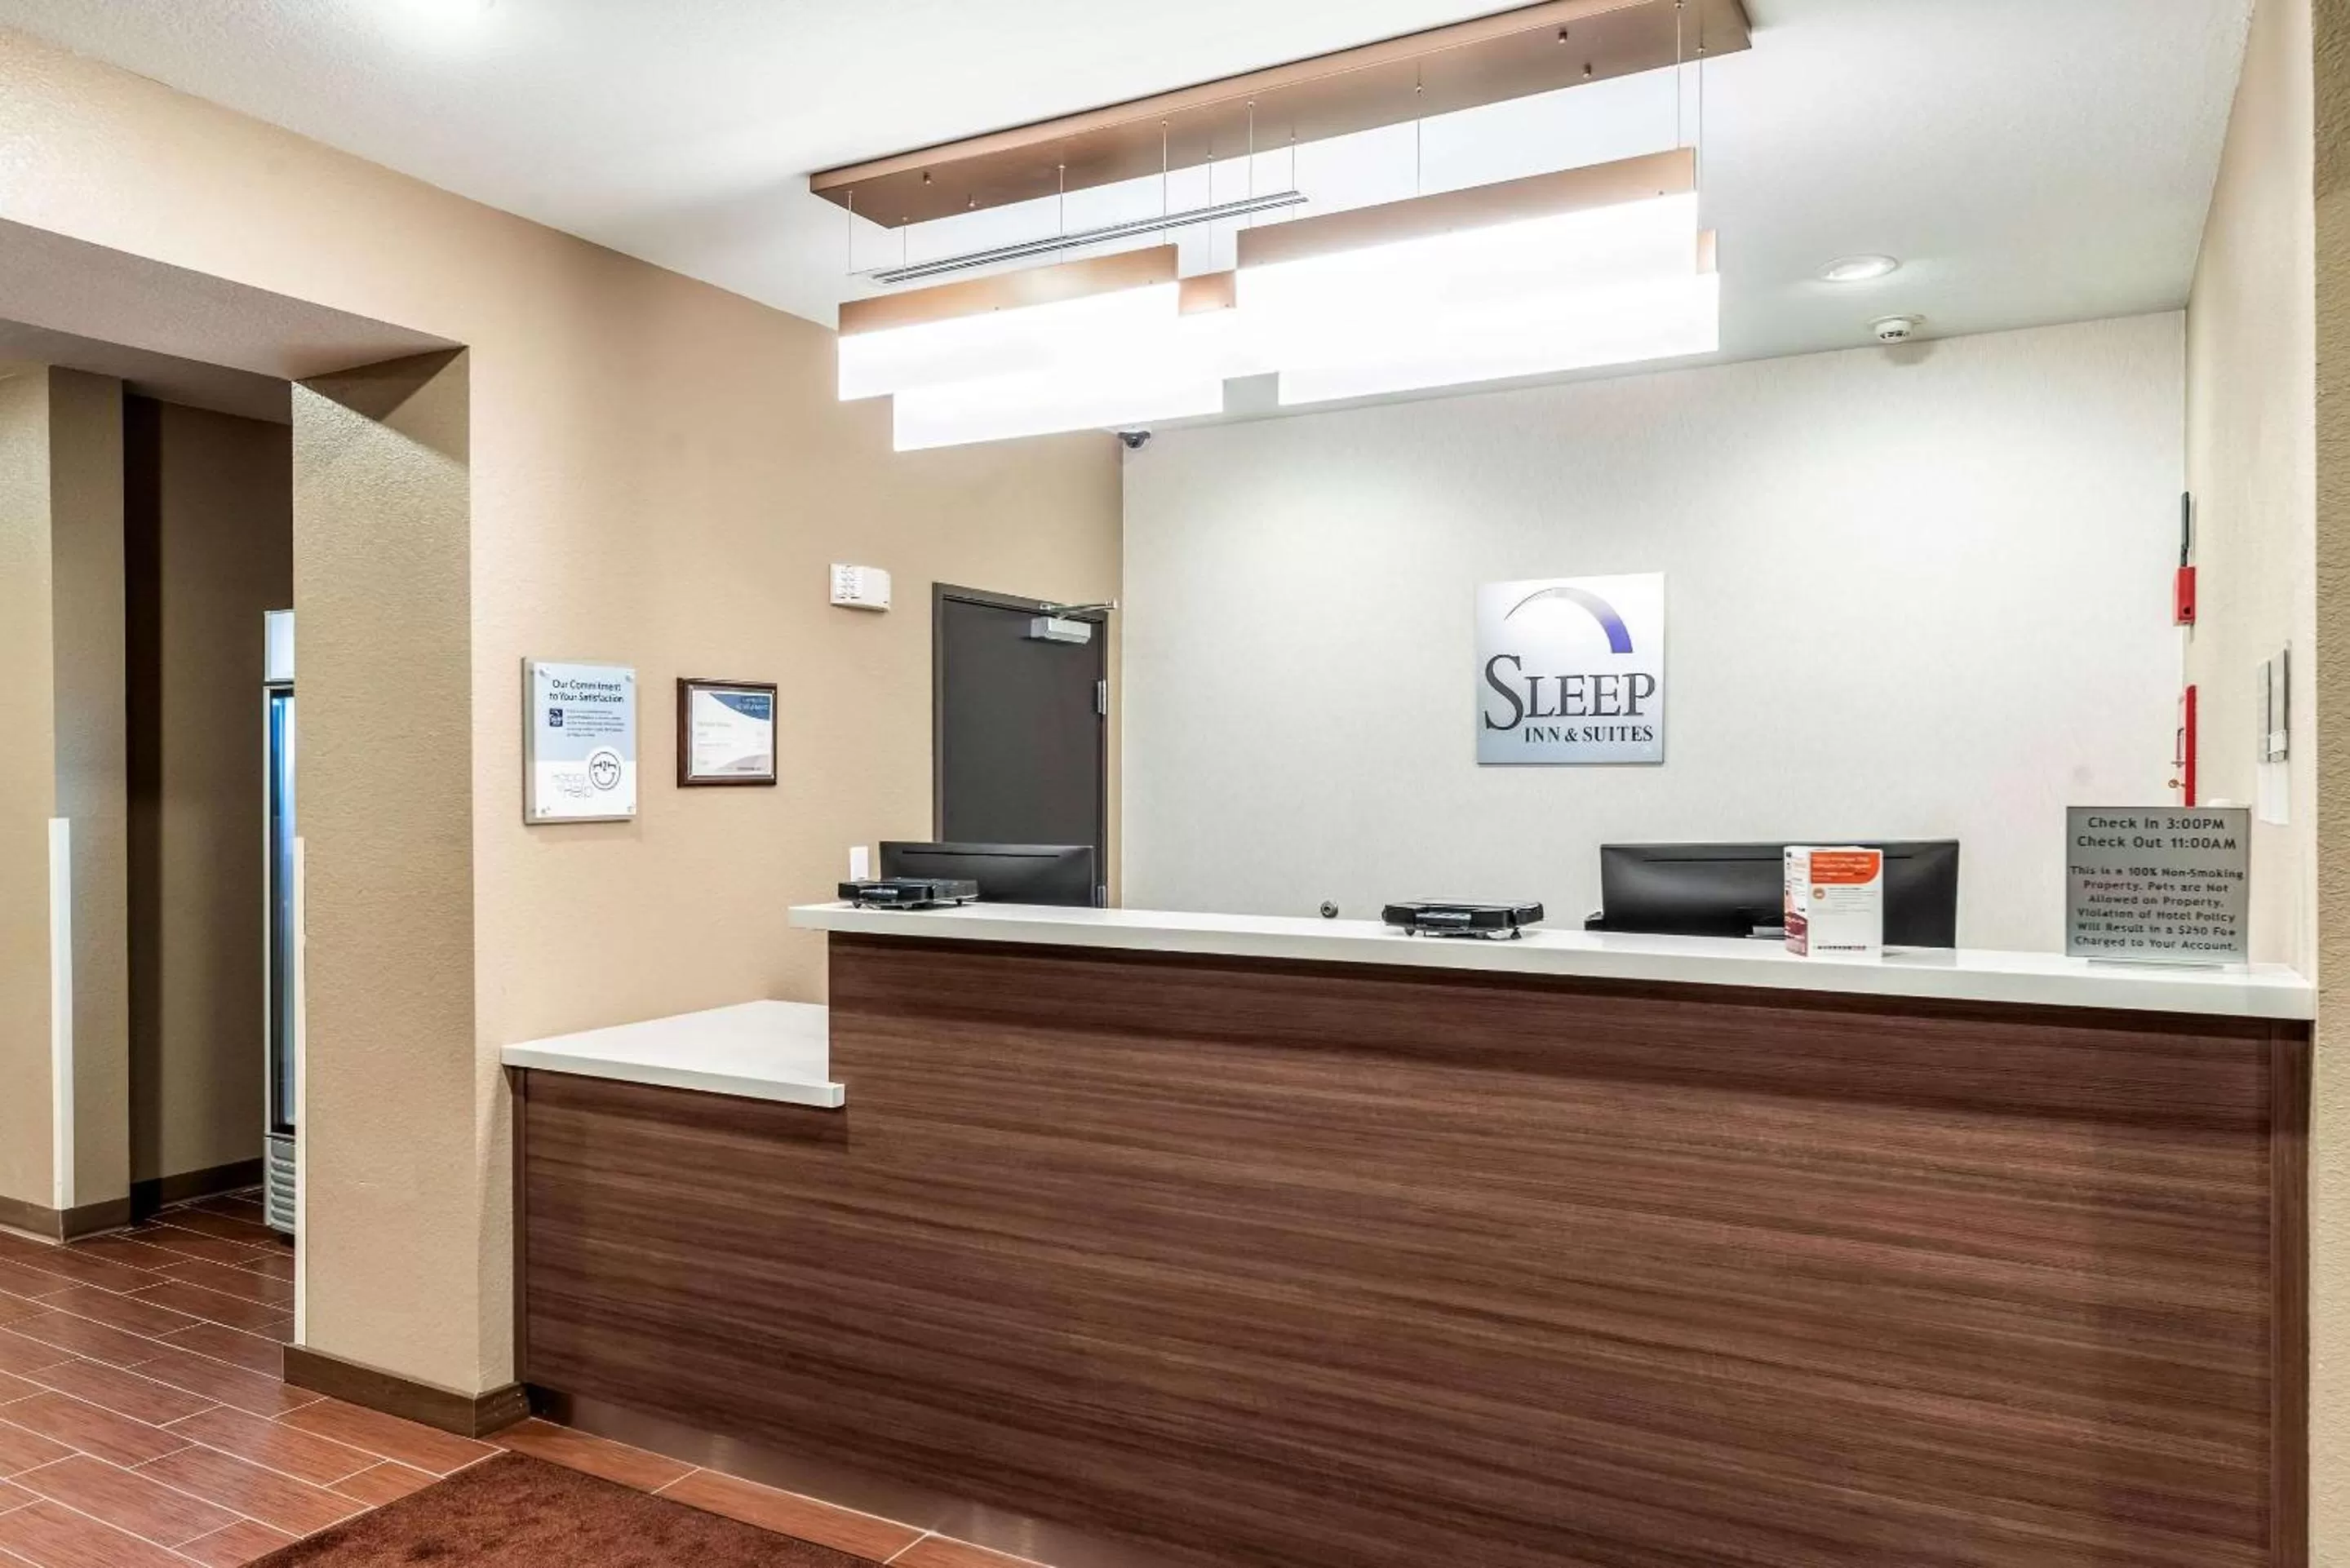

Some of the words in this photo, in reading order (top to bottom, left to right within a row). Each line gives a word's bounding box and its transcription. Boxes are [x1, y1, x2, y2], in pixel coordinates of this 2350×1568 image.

[552, 679, 569, 689] Our
[570, 679, 622, 692] Commitment
[1484, 653, 1656, 731] SLEEP
[549, 692, 558, 701] to
[559, 692, 577, 702] Your
[579, 692, 624, 703] Satisfaction
[1524, 726, 1561, 743] INN
[1563, 727, 1578, 742] &
[1582, 724, 1654, 742] SUITES
[2087, 817, 2138, 829] Check
[2144, 817, 2159, 830] In
[2166, 818, 2225, 830] 3:00PM
[2077, 835, 2126, 848] Check
[2133, 836, 2162, 848] Out
[2170, 837, 2237, 849] 11:00AM
[2069, 866, 2096, 875] This
[2101, 866, 2111, 875] is
[2115, 868, 2123, 876] a
[2128, 867, 2158, 877] 100%
[2162, 867, 2244, 880] Non-Smoking
[2083, 879, 2144, 892] Property.
[2148, 880, 2175, 891] Pets
[2180, 884, 2202, 892] are
[2206, 884, 2228, 893] Not
[2088, 895, 2138, 905] Allowed
[2162, 896, 2224, 909] Property.
[2077, 908, 2134, 919] Violation
[2139, 910, 2152, 919] of
[2157, 910, 2191, 920] Hotel
[2196, 912, 2237, 924] Policy
[2077, 922, 2101, 932] Will
[2105, 923, 2145, 933] Result
[2149, 924, 2162, 933] in
[2166, 927, 2174, 935] a
[2178, 925, 2208, 936] $250
[2213, 927, 2237, 937] Fee
[2074, 936, 2126, 948] Charged
[2131, 937, 2144, 947] to
[2149, 939, 2175, 949] Your
[2181, 941, 2239, 951] Account.
